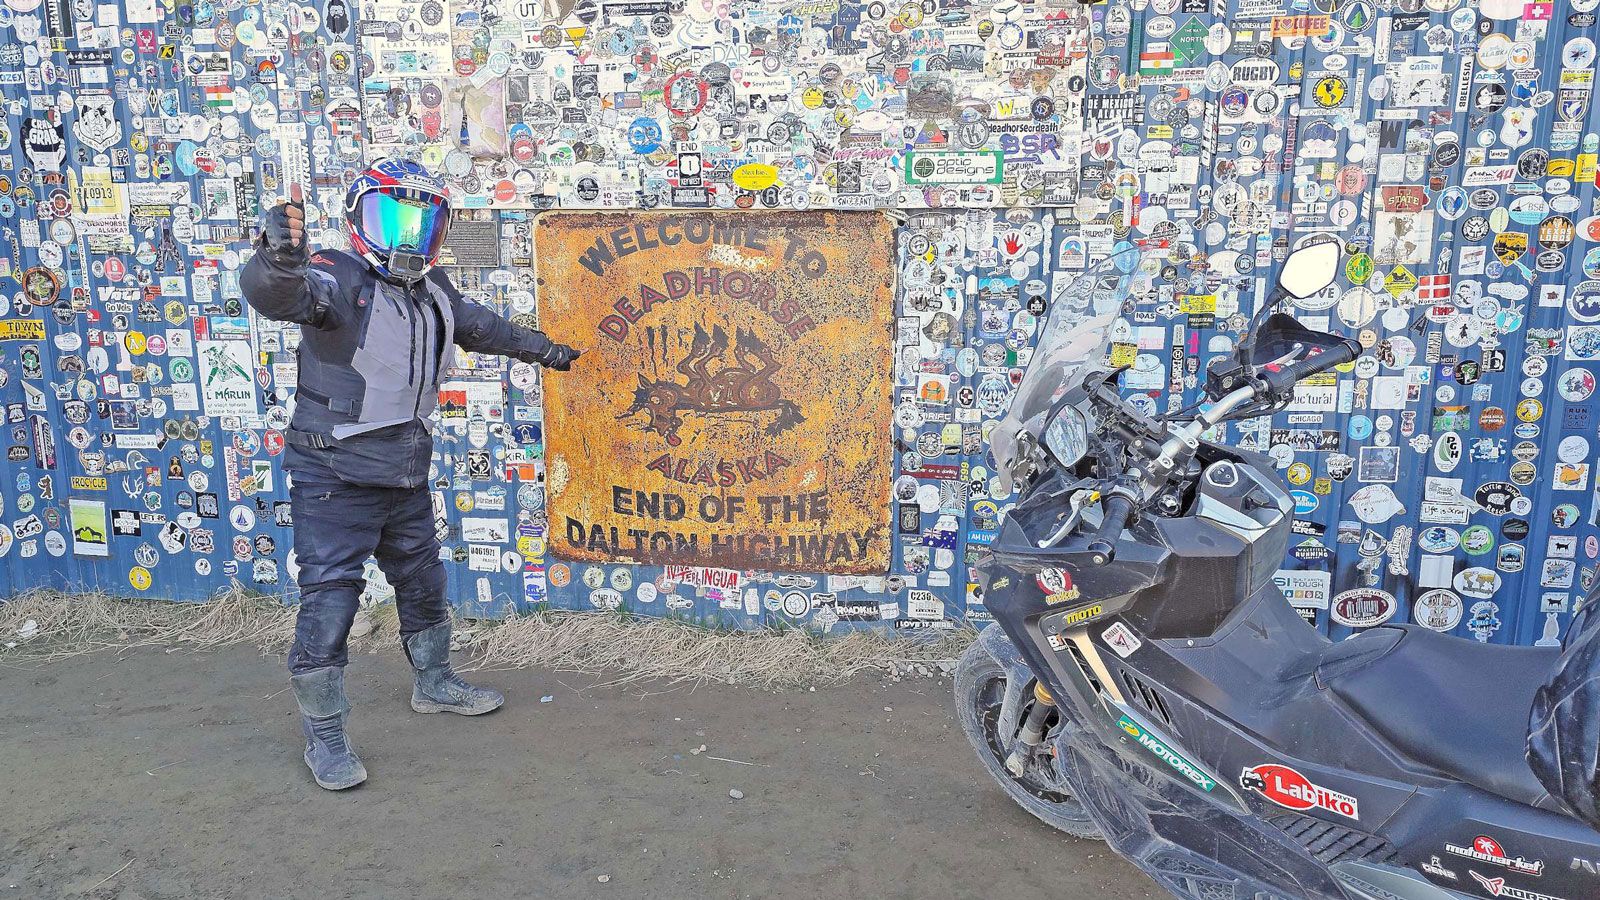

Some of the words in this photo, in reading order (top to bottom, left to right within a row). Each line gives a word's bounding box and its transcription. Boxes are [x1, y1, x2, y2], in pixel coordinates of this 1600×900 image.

[519, 3, 537, 17] UT
[712, 46, 749, 63] DAR
[1232, 65, 1276, 82] RUGBY
[997, 99, 1030, 117] WISE
[1101, 100, 1134, 109] MEXICO
[987, 121, 1059, 133] deadhorseordeath
[29, 128, 62, 146] GRAB
[681, 143, 698, 153] END
[936, 158, 972, 168] optic
[936, 165, 995, 178] designs
[1388, 194, 1420, 206] STATE
[578, 218, 769, 278] WELCOME
[782, 226, 829, 279] TO
[105, 303, 117, 312] Go
[597, 266, 819, 344] DEADHORSE
[214, 388, 251, 402] MARLIN
[646, 450, 792, 487] ALASKA
[1480, 482, 1502, 495] Turtle
[612, 485, 686, 522] END
[698, 494, 745, 524] OF
[757, 490, 829, 524] THE
[565, 515, 698, 557] DALTON
[711, 526, 880, 565] HIGHWAY
[836, 604, 880, 616] ROADKILL
[1139, 733, 1214, 790] MOTOREX
[1273, 775, 1355, 817] Labiko
[1445, 843, 1542, 873] motomarket
